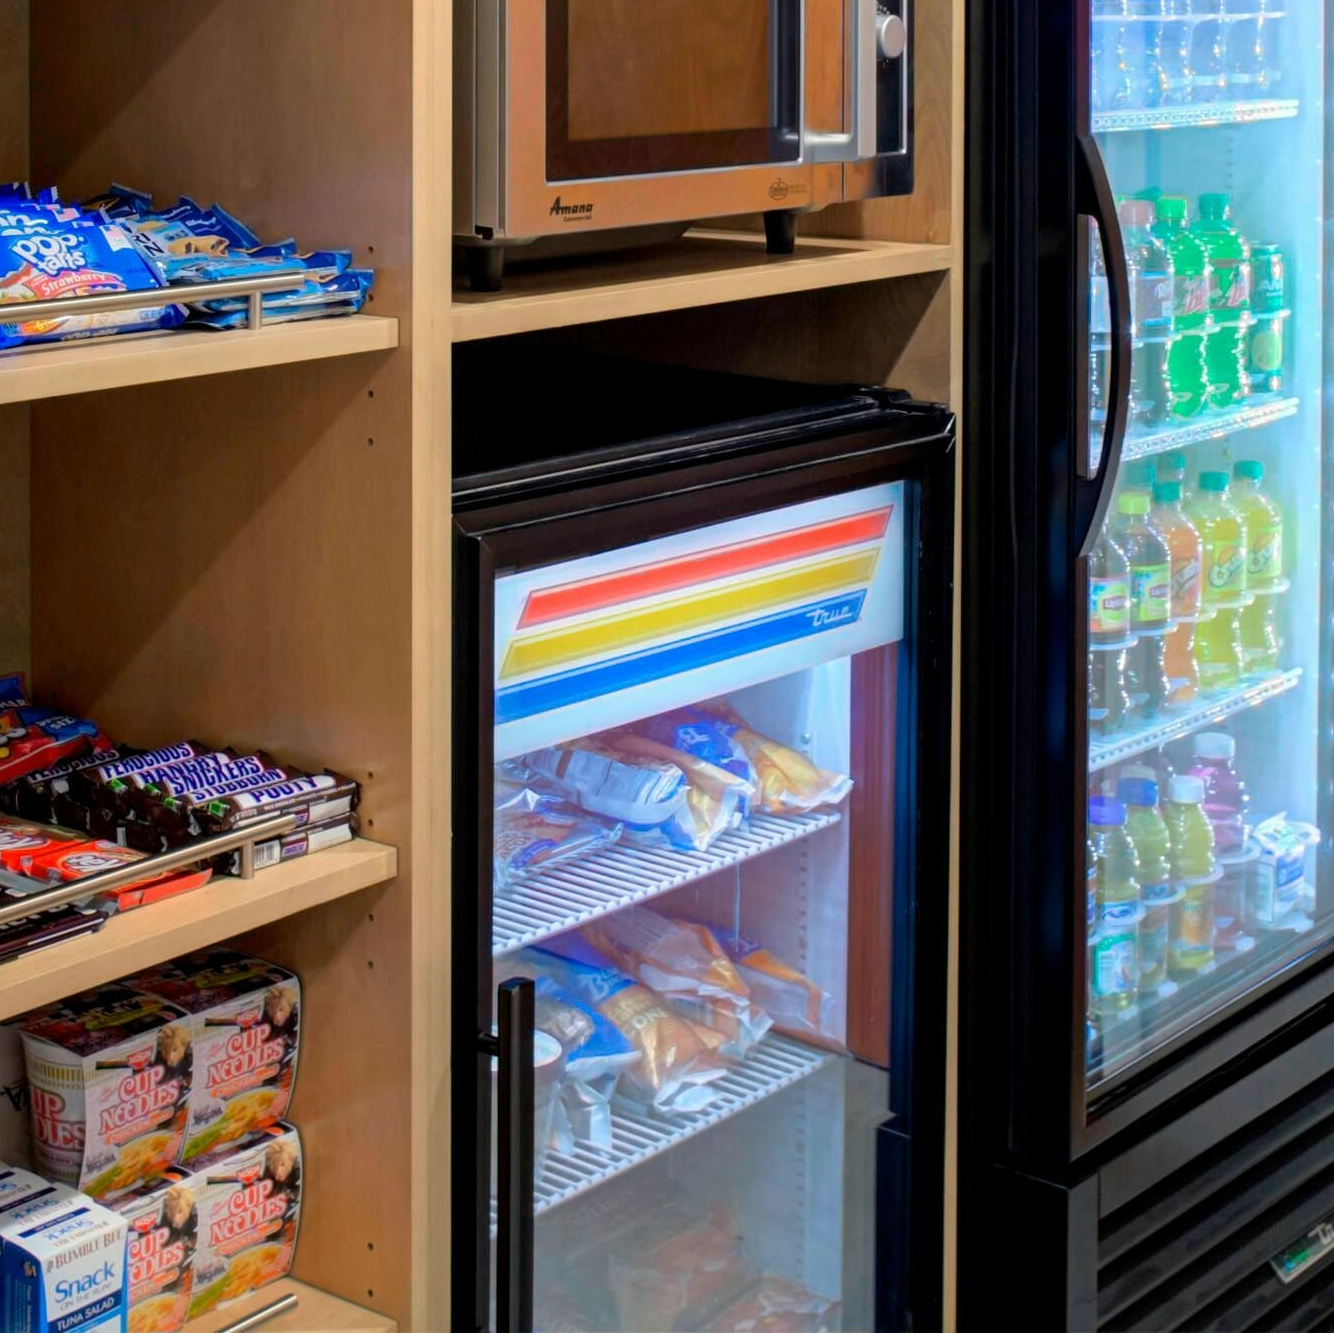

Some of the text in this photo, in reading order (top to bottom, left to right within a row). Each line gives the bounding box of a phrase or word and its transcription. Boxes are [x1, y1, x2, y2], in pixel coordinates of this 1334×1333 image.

[549, 195, 594, 216] Amana
[40, 271, 107, 296] Strawberry
[104, 742, 192, 780] FEROCIOUS
[137, 753, 222, 786] HANGRY
[171, 756, 262, 796] SNICKERS
[250, 776, 318, 804] POUTY
[226, 1023, 272, 1058] CUP
[205, 1036, 285, 1090] NOODLES
[30, 1086, 66, 1118] UP
[118, 1064, 166, 1103] CUP
[99, 1079, 180, 1136] NOODLES
[228, 1178, 274, 1216] CUP
[209, 1192, 288, 1248] NOODLES
[55, 1229, 121, 1269] BUMBLE BEE
[128, 1226, 171, 1264] CUP
[129, 1241, 186, 1285] ODLES
[54, 1260, 116, 1304] Snack
[57, 1296, 116, 1331] TUNA SALAD
